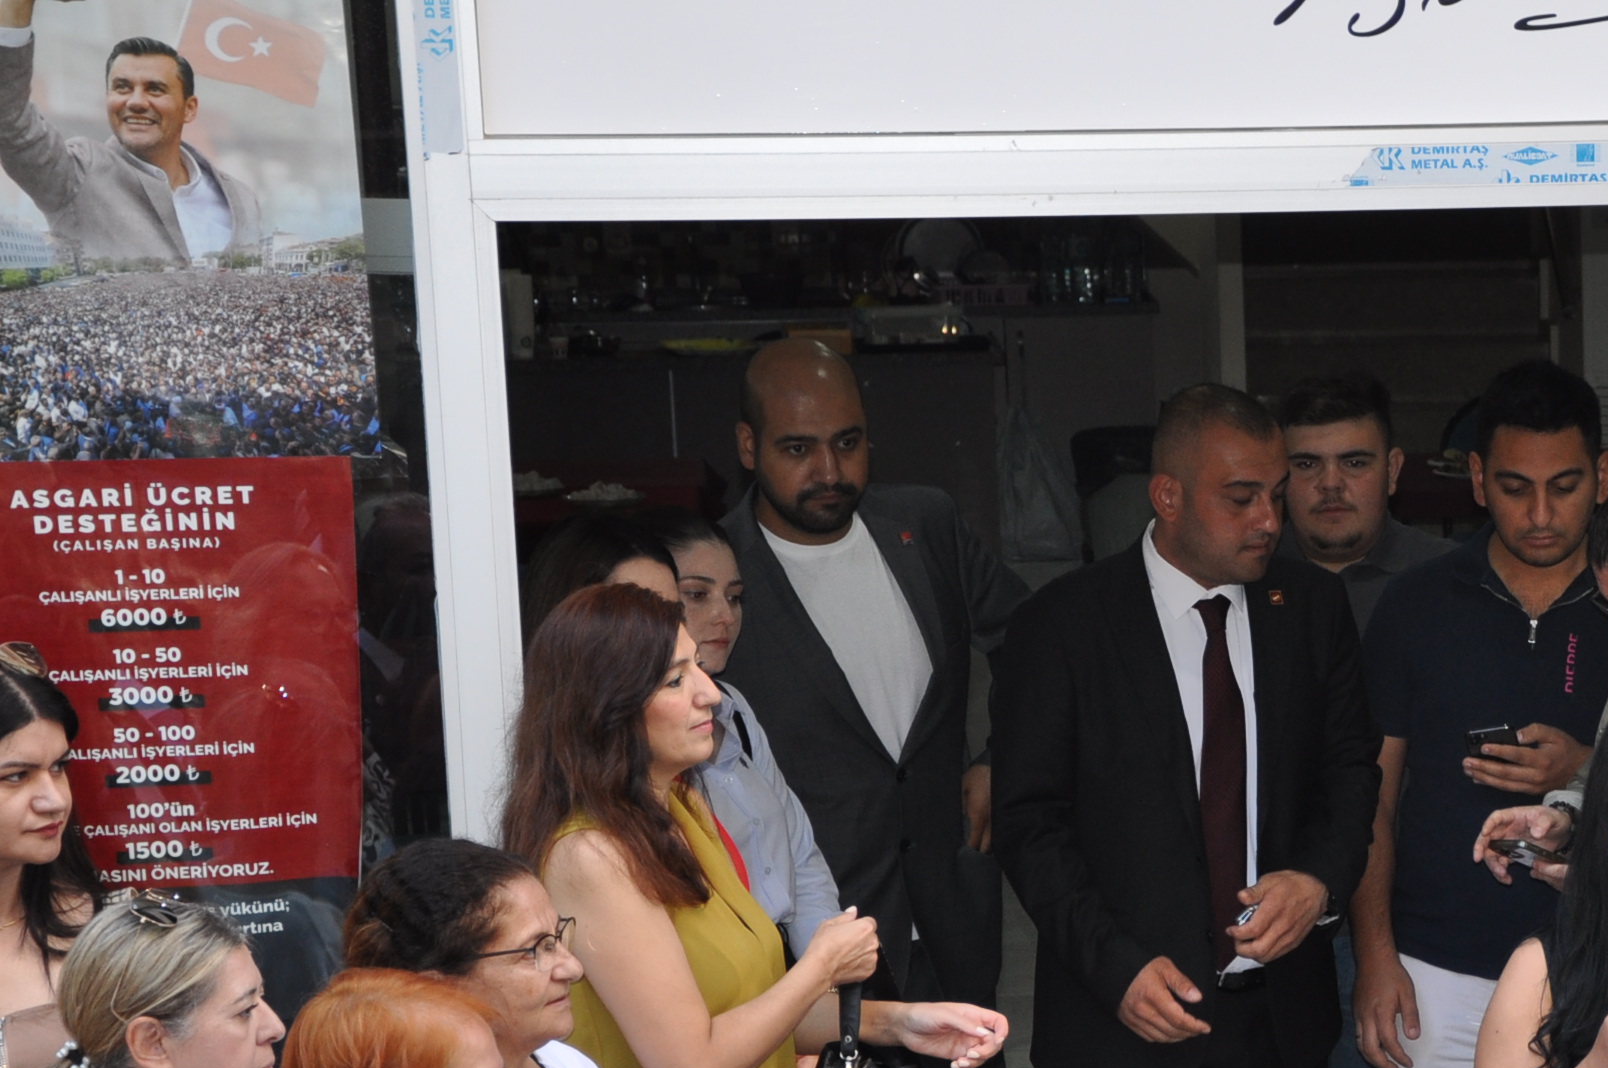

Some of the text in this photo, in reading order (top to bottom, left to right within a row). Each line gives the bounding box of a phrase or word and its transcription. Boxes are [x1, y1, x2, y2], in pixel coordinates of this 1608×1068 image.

[1411, 158, 1488, 171] METAL A.Ş.
[10, 482, 255, 508] ASGARİ ÜCRET
[33, 509, 236, 535] DESTEĞİNİN
[53, 537, 220, 552] (ÇALIŞAN BAŞINA)
[114, 570, 123, 585] 1
[142, 569, 165, 584] 10
[38, 584, 240, 605] ÇALIŞANLI İŞYERLERİ İÇİN
[100, 608, 167, 627] 6000
[113, 648, 136, 664] 10
[156, 647, 181, 663] 50
[49, 662, 248, 684] ÇALIŞANLI İŞYERLERİ İÇİN
[109, 686, 174, 706] 3000
[113, 727, 139, 743] 50
[158, 725, 196, 742] 100
[67, 740, 255, 761] ALIŞANLI İŞYERLERİ İÇİN
[116, 764, 180, 785] 2000
[83, 821, 156, 838] ÇALIŞANI
[158, 819, 203, 833] OLAN
[205, 814, 283, 833] İŞYERLERİ
[286, 812, 318, 829] İÇİN
[125, 840, 184, 860] 1500
[98, 861, 275, 883] ASINI ÖNERİYORUZ.
[219, 899, 291, 917] yükünü;
